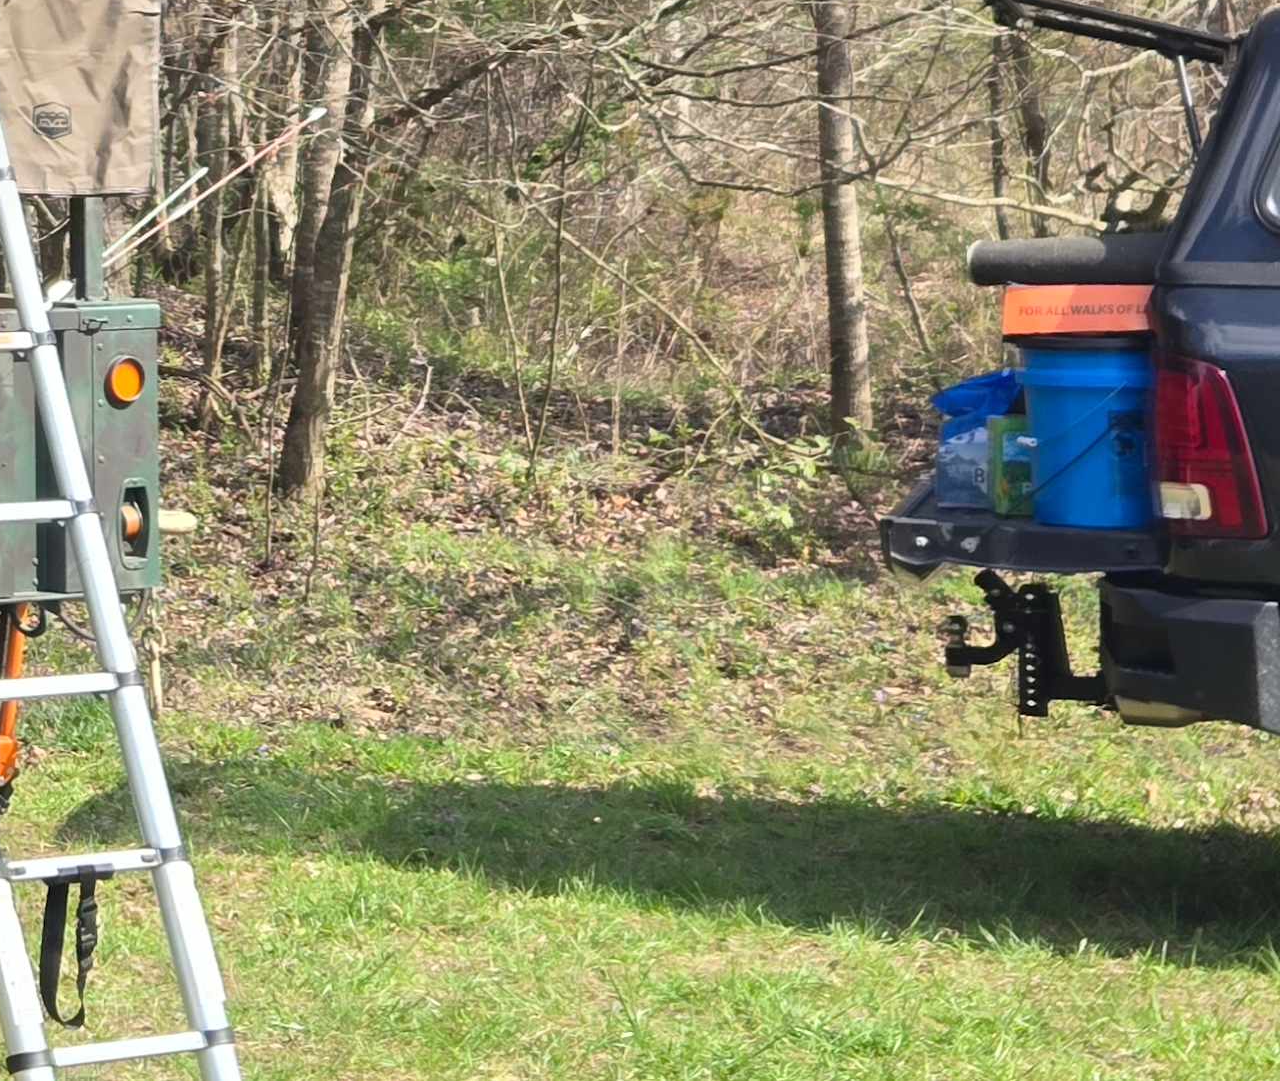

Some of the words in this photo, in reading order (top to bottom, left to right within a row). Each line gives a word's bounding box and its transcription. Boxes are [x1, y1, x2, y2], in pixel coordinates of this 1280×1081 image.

[1019, 306, 1040, 317] FOR
[1046, 305, 1068, 316] ALL
[1070, 304, 1116, 316] WALKS
[1117, 303, 1135, 315] OF
